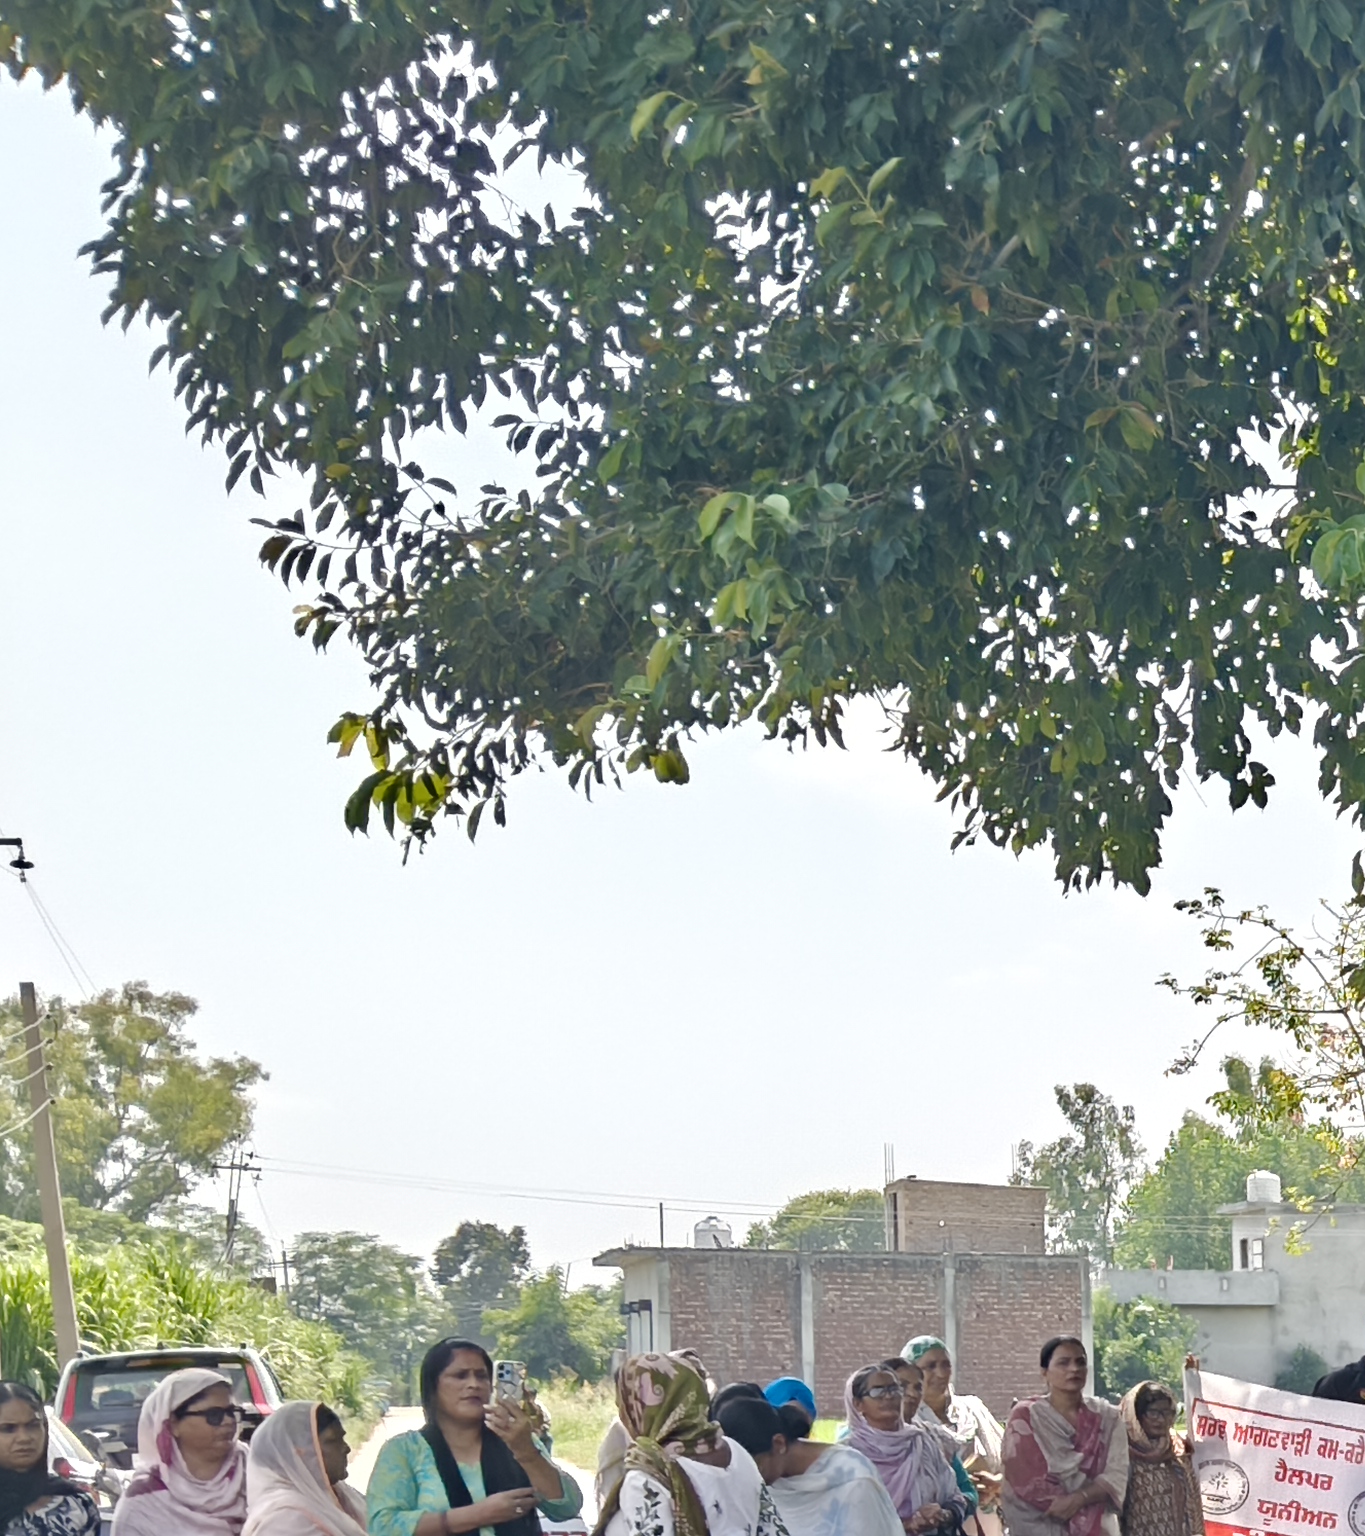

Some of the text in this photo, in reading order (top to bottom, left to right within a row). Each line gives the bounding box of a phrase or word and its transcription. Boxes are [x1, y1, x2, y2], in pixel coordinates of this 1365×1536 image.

[1196, 1414, 1227, 1440] ਸਰਵ
[1274, 1457, 1334, 1491] ਹੈਲਪਰ
[1257, 1498, 1339, 1530] ਯੂਨੀਅਨ
